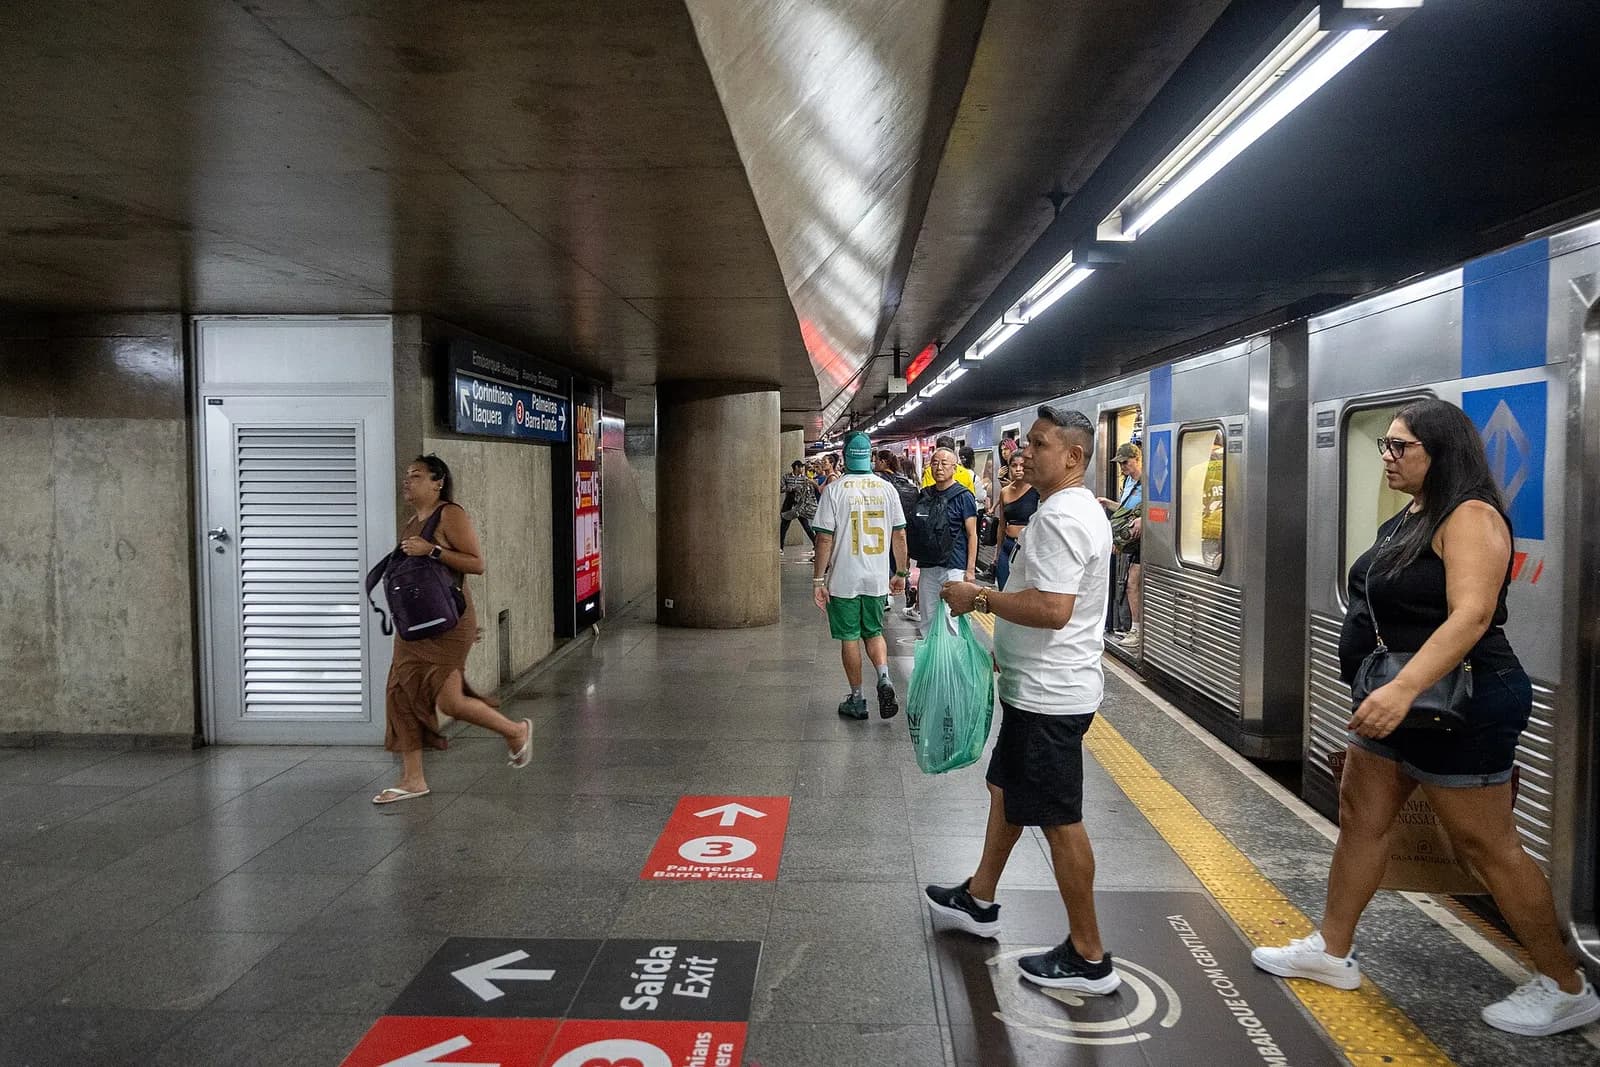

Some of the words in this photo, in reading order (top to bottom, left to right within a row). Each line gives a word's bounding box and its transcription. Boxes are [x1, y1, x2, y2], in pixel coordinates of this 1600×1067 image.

[472, 380, 513, 406] Corinthians
[531, 394, 558, 415] Palmeiras
[472, 402, 503, 428] Itaquera
[525, 411, 540, 429] Barra
[541, 414, 558, 432] Funda
[850, 511, 885, 555] 15
[700, 841, 733, 857] 3
[653, 871, 701, 879] Barra
[707, 871, 763, 879] Funda
[666, 864, 755, 873] Palmeiras
[1166, 914, 1219, 967] GENTILEZA
[620, 945, 678, 1011] Saída
[672, 955, 719, 998] Exit
[1203, 968, 1240, 998] COM
